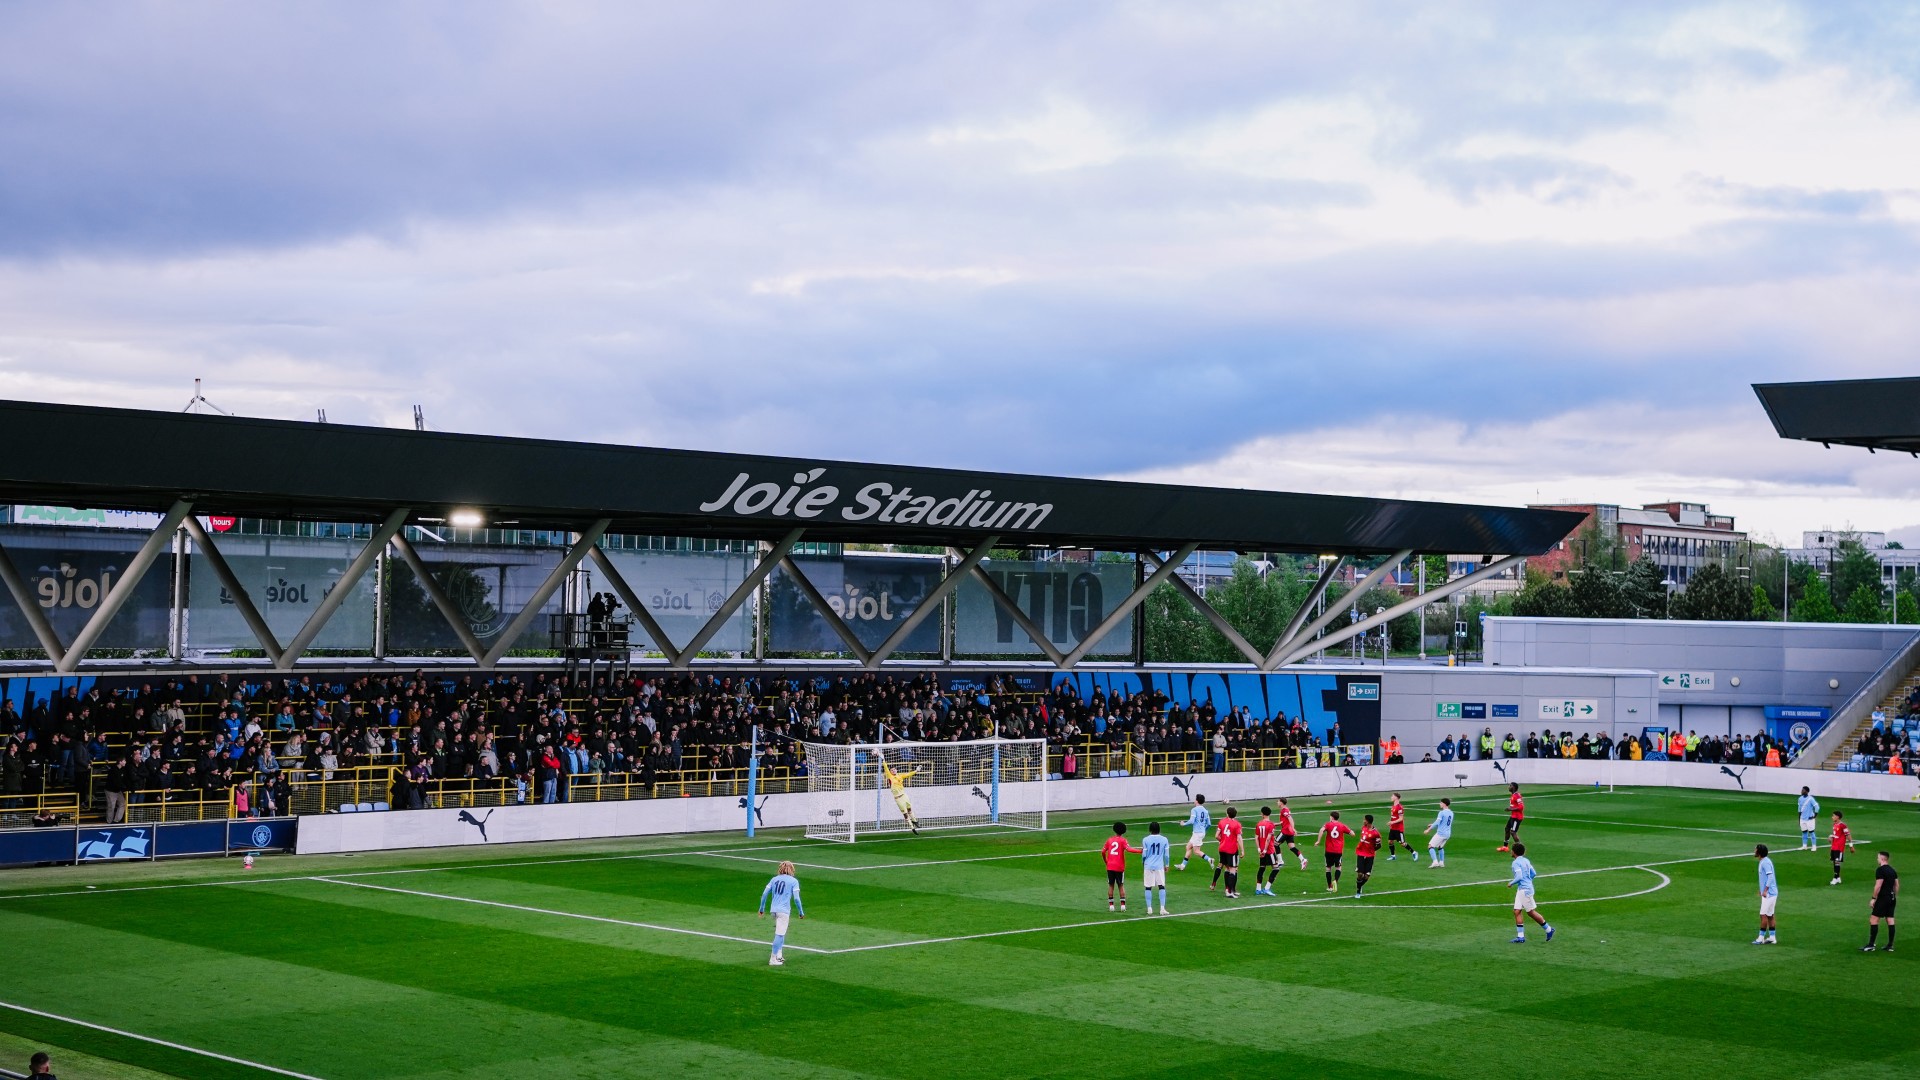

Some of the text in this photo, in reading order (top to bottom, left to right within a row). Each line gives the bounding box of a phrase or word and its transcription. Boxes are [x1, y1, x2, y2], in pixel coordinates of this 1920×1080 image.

[699, 467, 1054, 530] Joie Stadium
[212, 517, 232, 526] hours
[1694, 677, 1711, 685] Exit
[1542, 705, 1559, 713] Exit
[1200, 811, 1205, 823] 9
[1223, 823, 1231, 838] 4
[1258, 825, 1266, 839] 11
[1330, 825, 1340, 839] 6
[1110, 841, 1119, 856] 2
[1150, 842, 1161, 856] 11
[774, 879, 786, 895] 10
